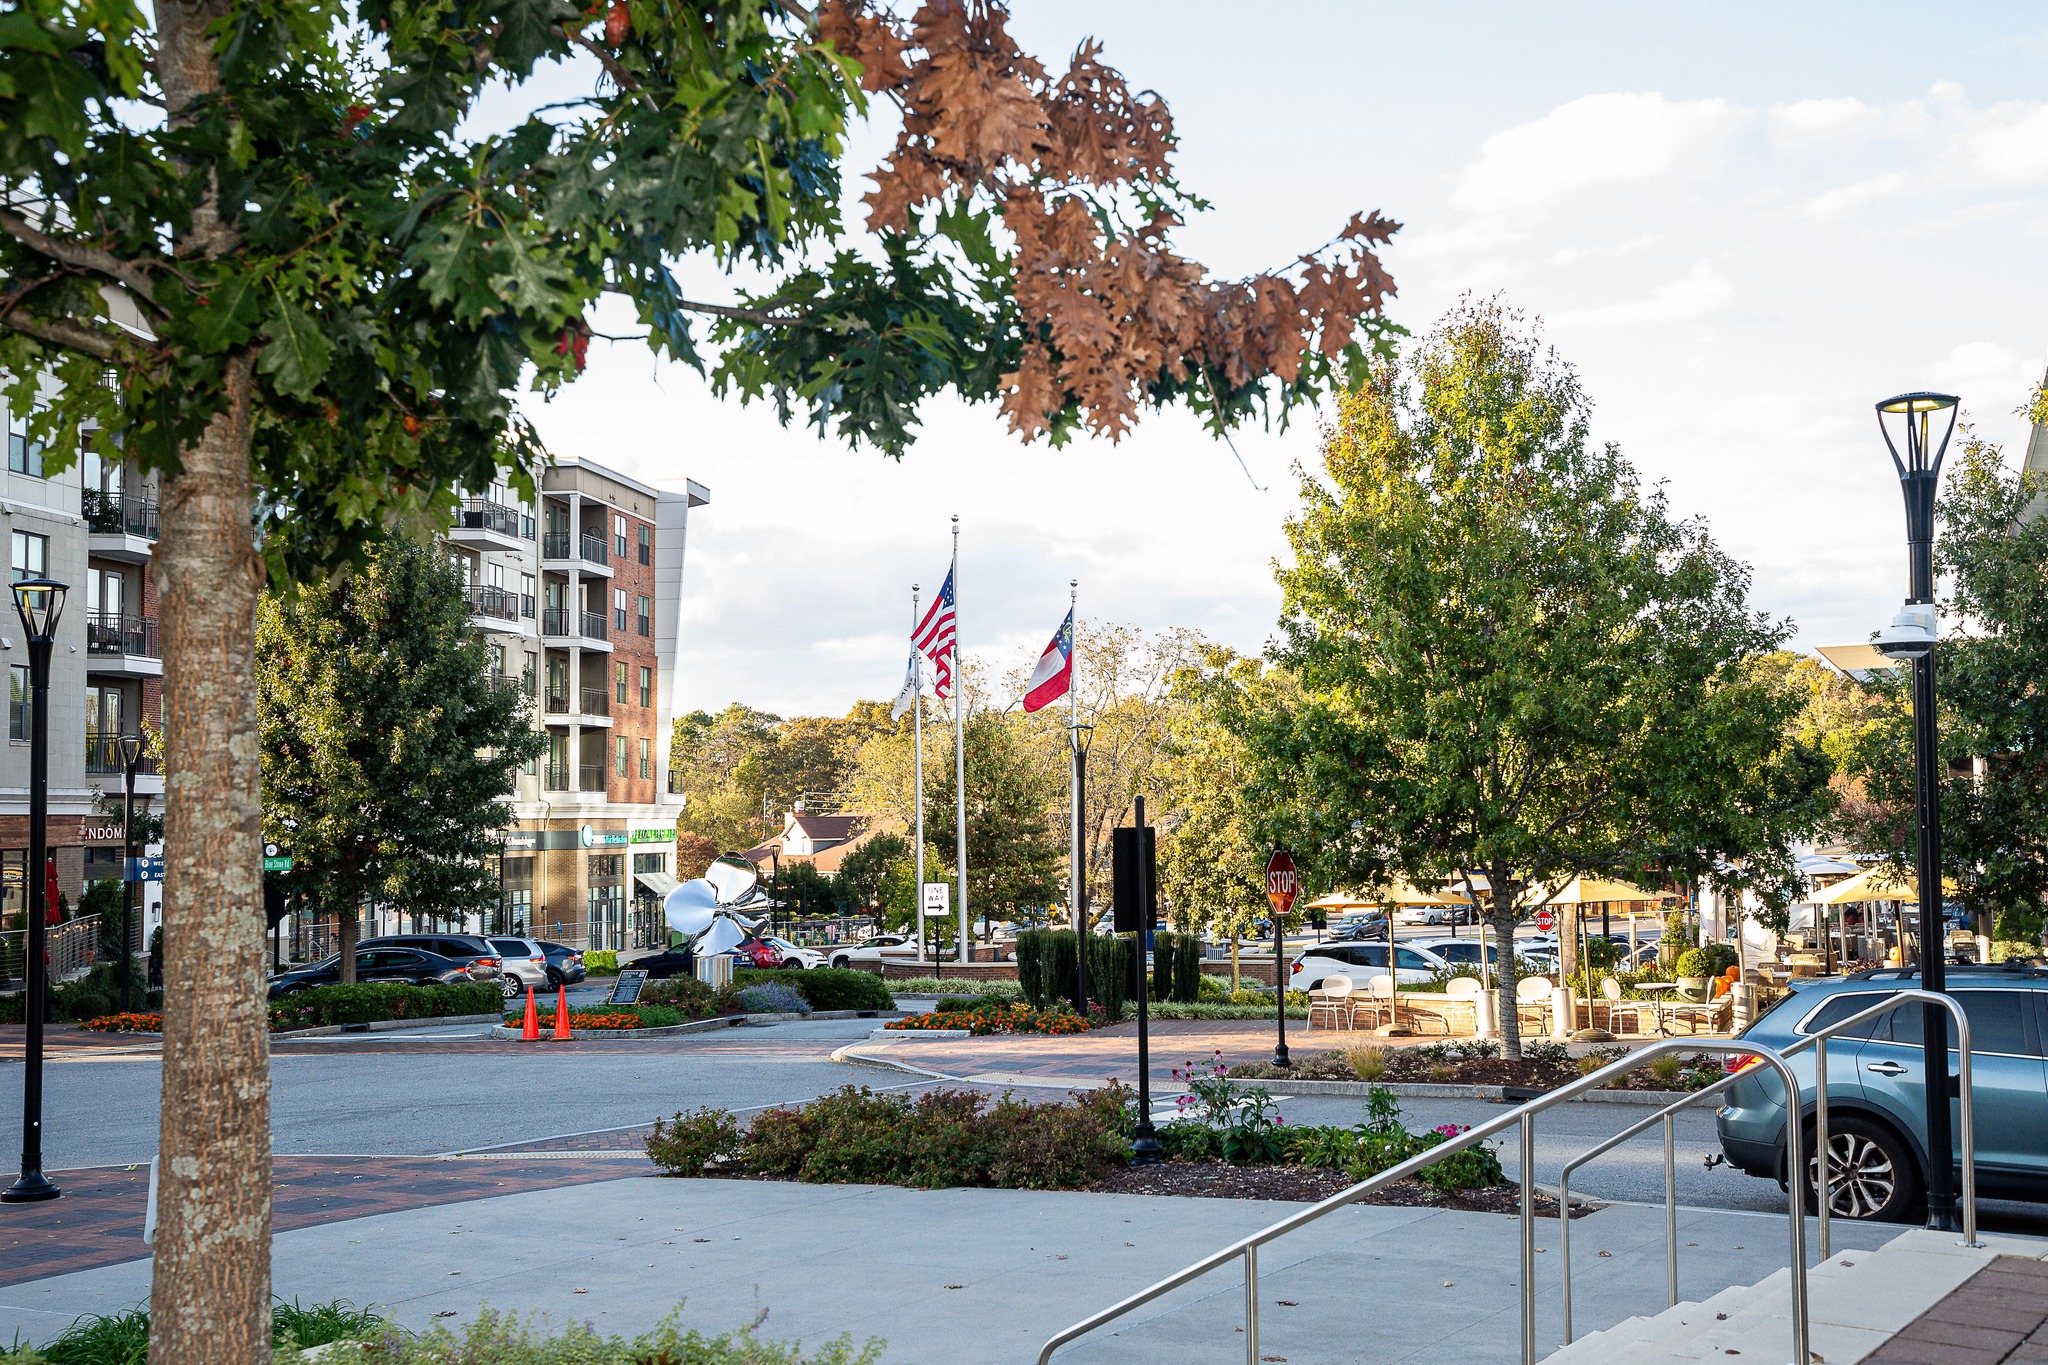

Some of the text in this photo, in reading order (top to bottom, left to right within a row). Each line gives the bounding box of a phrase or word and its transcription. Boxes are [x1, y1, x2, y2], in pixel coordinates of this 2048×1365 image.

[85, 824, 125, 839] NDÔM
[265, 860, 273, 868] Blue
[274, 860, 283, 868] Stone
[1269, 871, 1295, 893] STOP
[1537, 917, 1553, 925] STOP
